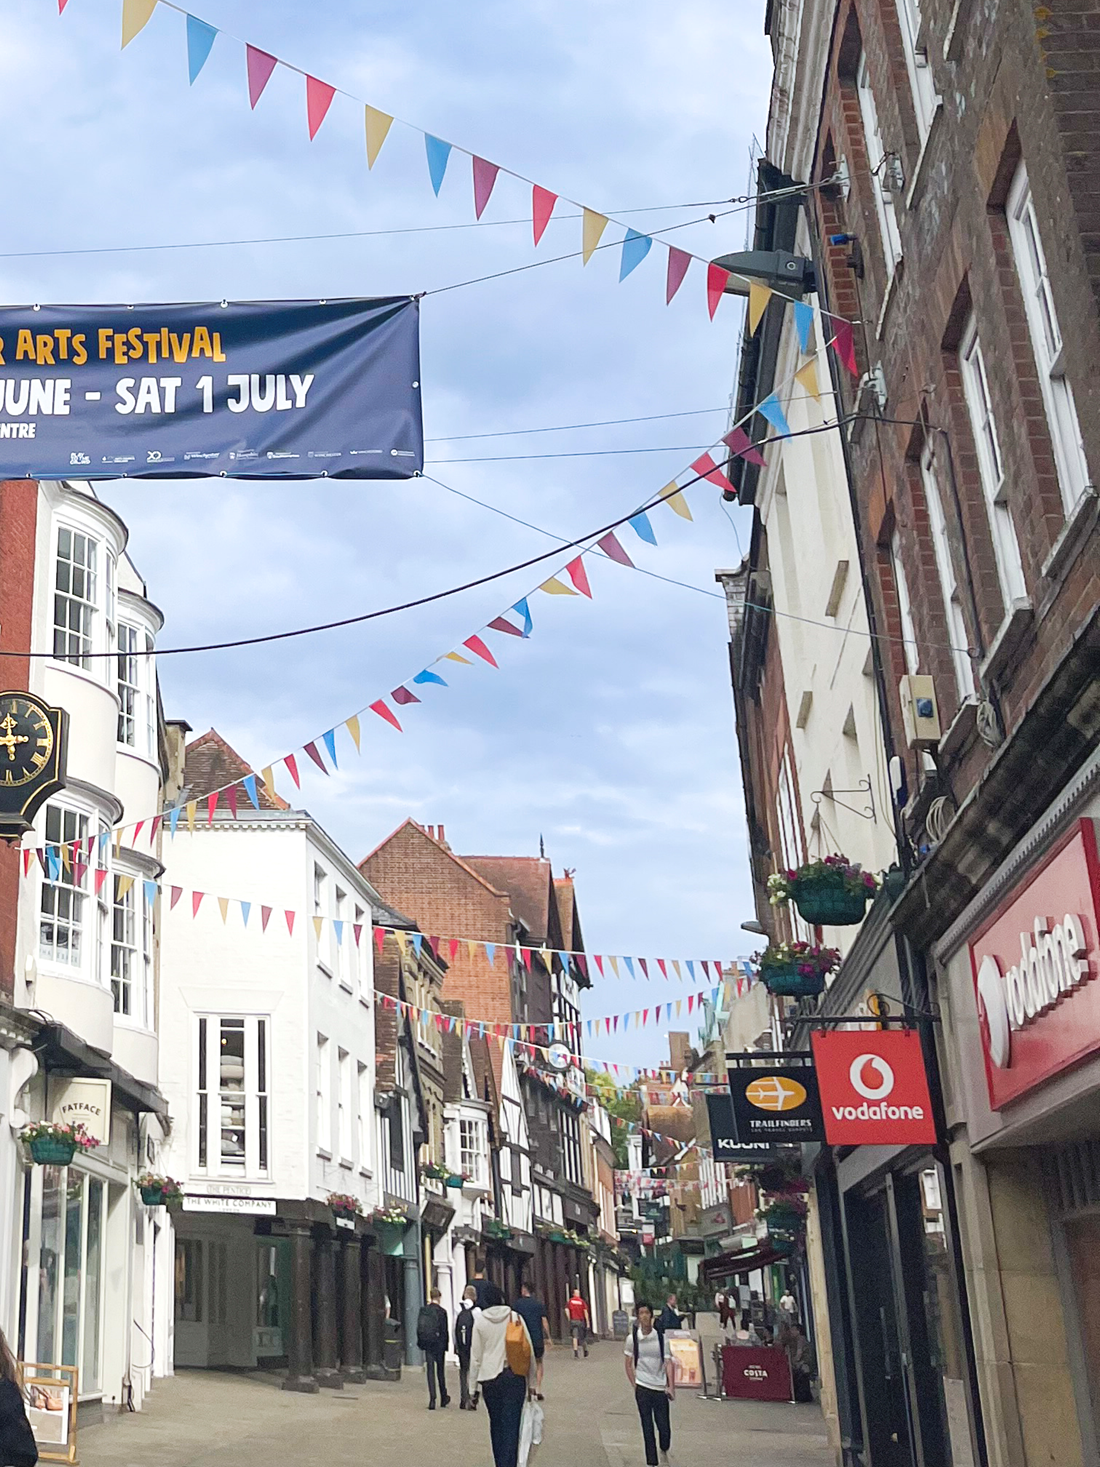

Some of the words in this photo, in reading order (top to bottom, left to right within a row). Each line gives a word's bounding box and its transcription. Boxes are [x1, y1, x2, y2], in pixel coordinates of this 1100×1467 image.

[15, 328, 88, 366] ARTS
[98, 326, 227, 364] FESTIVAL
[114, 377, 182, 415] SAT
[195, 375, 214, 414] 1
[227, 373, 315, 414] JULY
[1003, 913, 1090, 1032] vodafone
[62, 1102, 101, 1116] FATFACE
[831, 1101, 924, 1121] vodafone
[749, 1119, 812, 1128] TRAILFINDERS
[186, 1197, 201, 1206] THE
[204, 1198, 230, 1207] WHITE
[232, 1199, 272, 1208] COMPANY
[743, 1369, 768, 1378] COSTA
